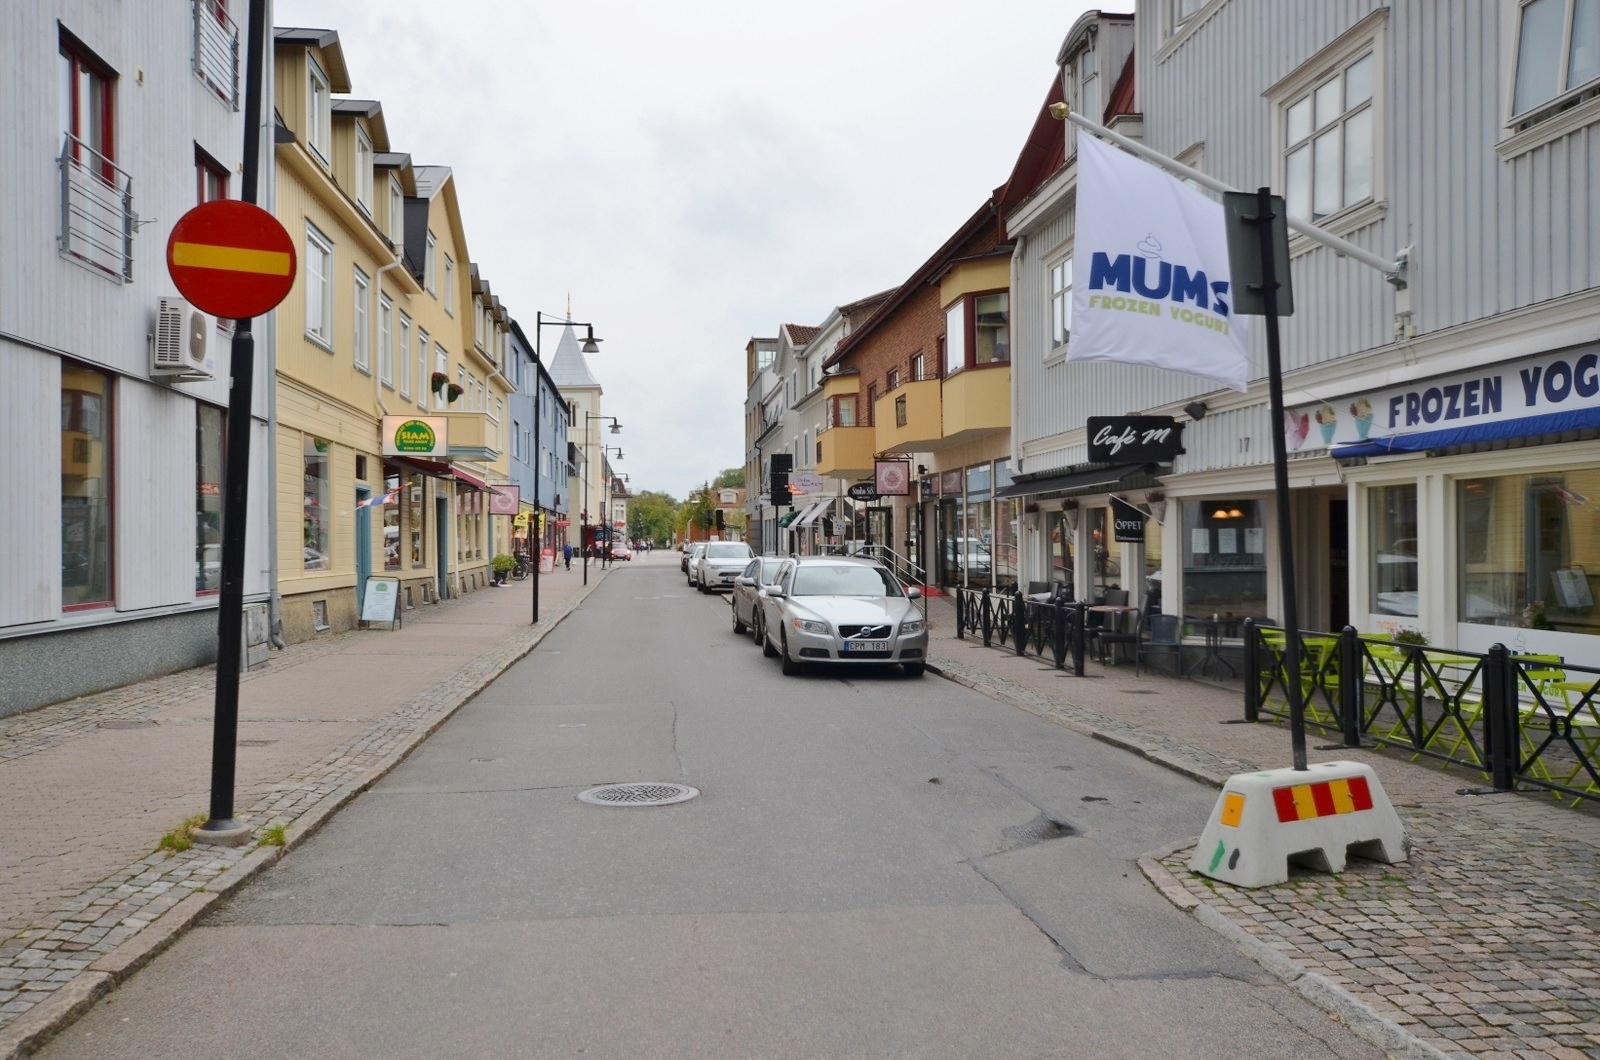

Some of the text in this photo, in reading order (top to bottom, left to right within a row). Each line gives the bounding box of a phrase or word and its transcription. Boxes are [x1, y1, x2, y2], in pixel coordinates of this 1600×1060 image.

[1089, 252, 1230, 316] MUMS
[1089, 295, 1230, 336] FROZEN YOGURT
[1388, 354, 1599, 429] FROZEN YOG
[401, 431, 430, 440] SIAM
[1093, 425, 1172, 456] Café M
[1239, 437, 1250, 454] 17
[1115, 519, 1142, 530] ÖPPET
